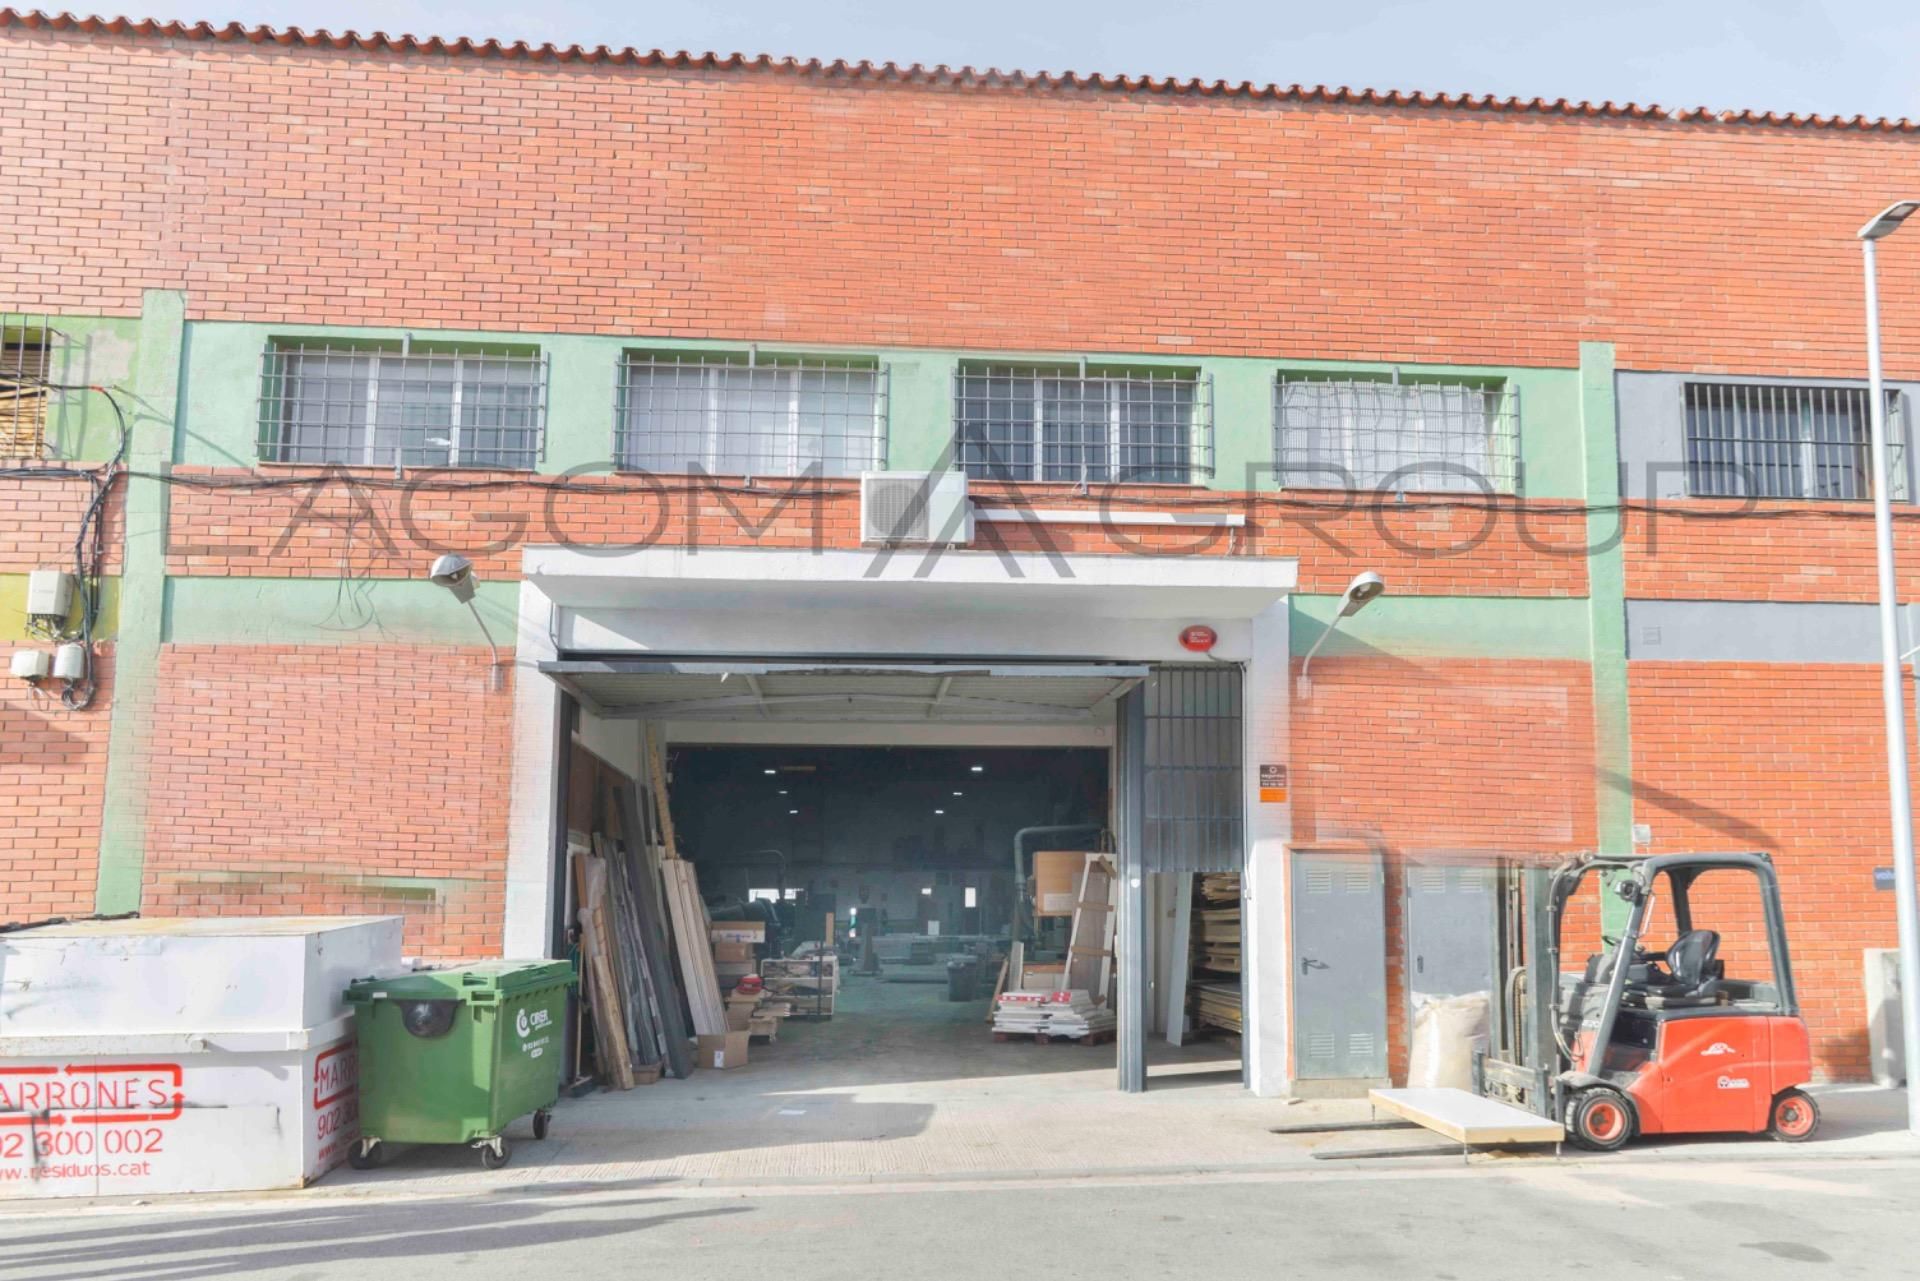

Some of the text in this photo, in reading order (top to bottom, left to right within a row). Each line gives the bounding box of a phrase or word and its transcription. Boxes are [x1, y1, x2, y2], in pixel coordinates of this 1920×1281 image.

[0, 1127, 164, 1158] 2 300 002
[0, 1161, 151, 1180] w.residuos.cat
